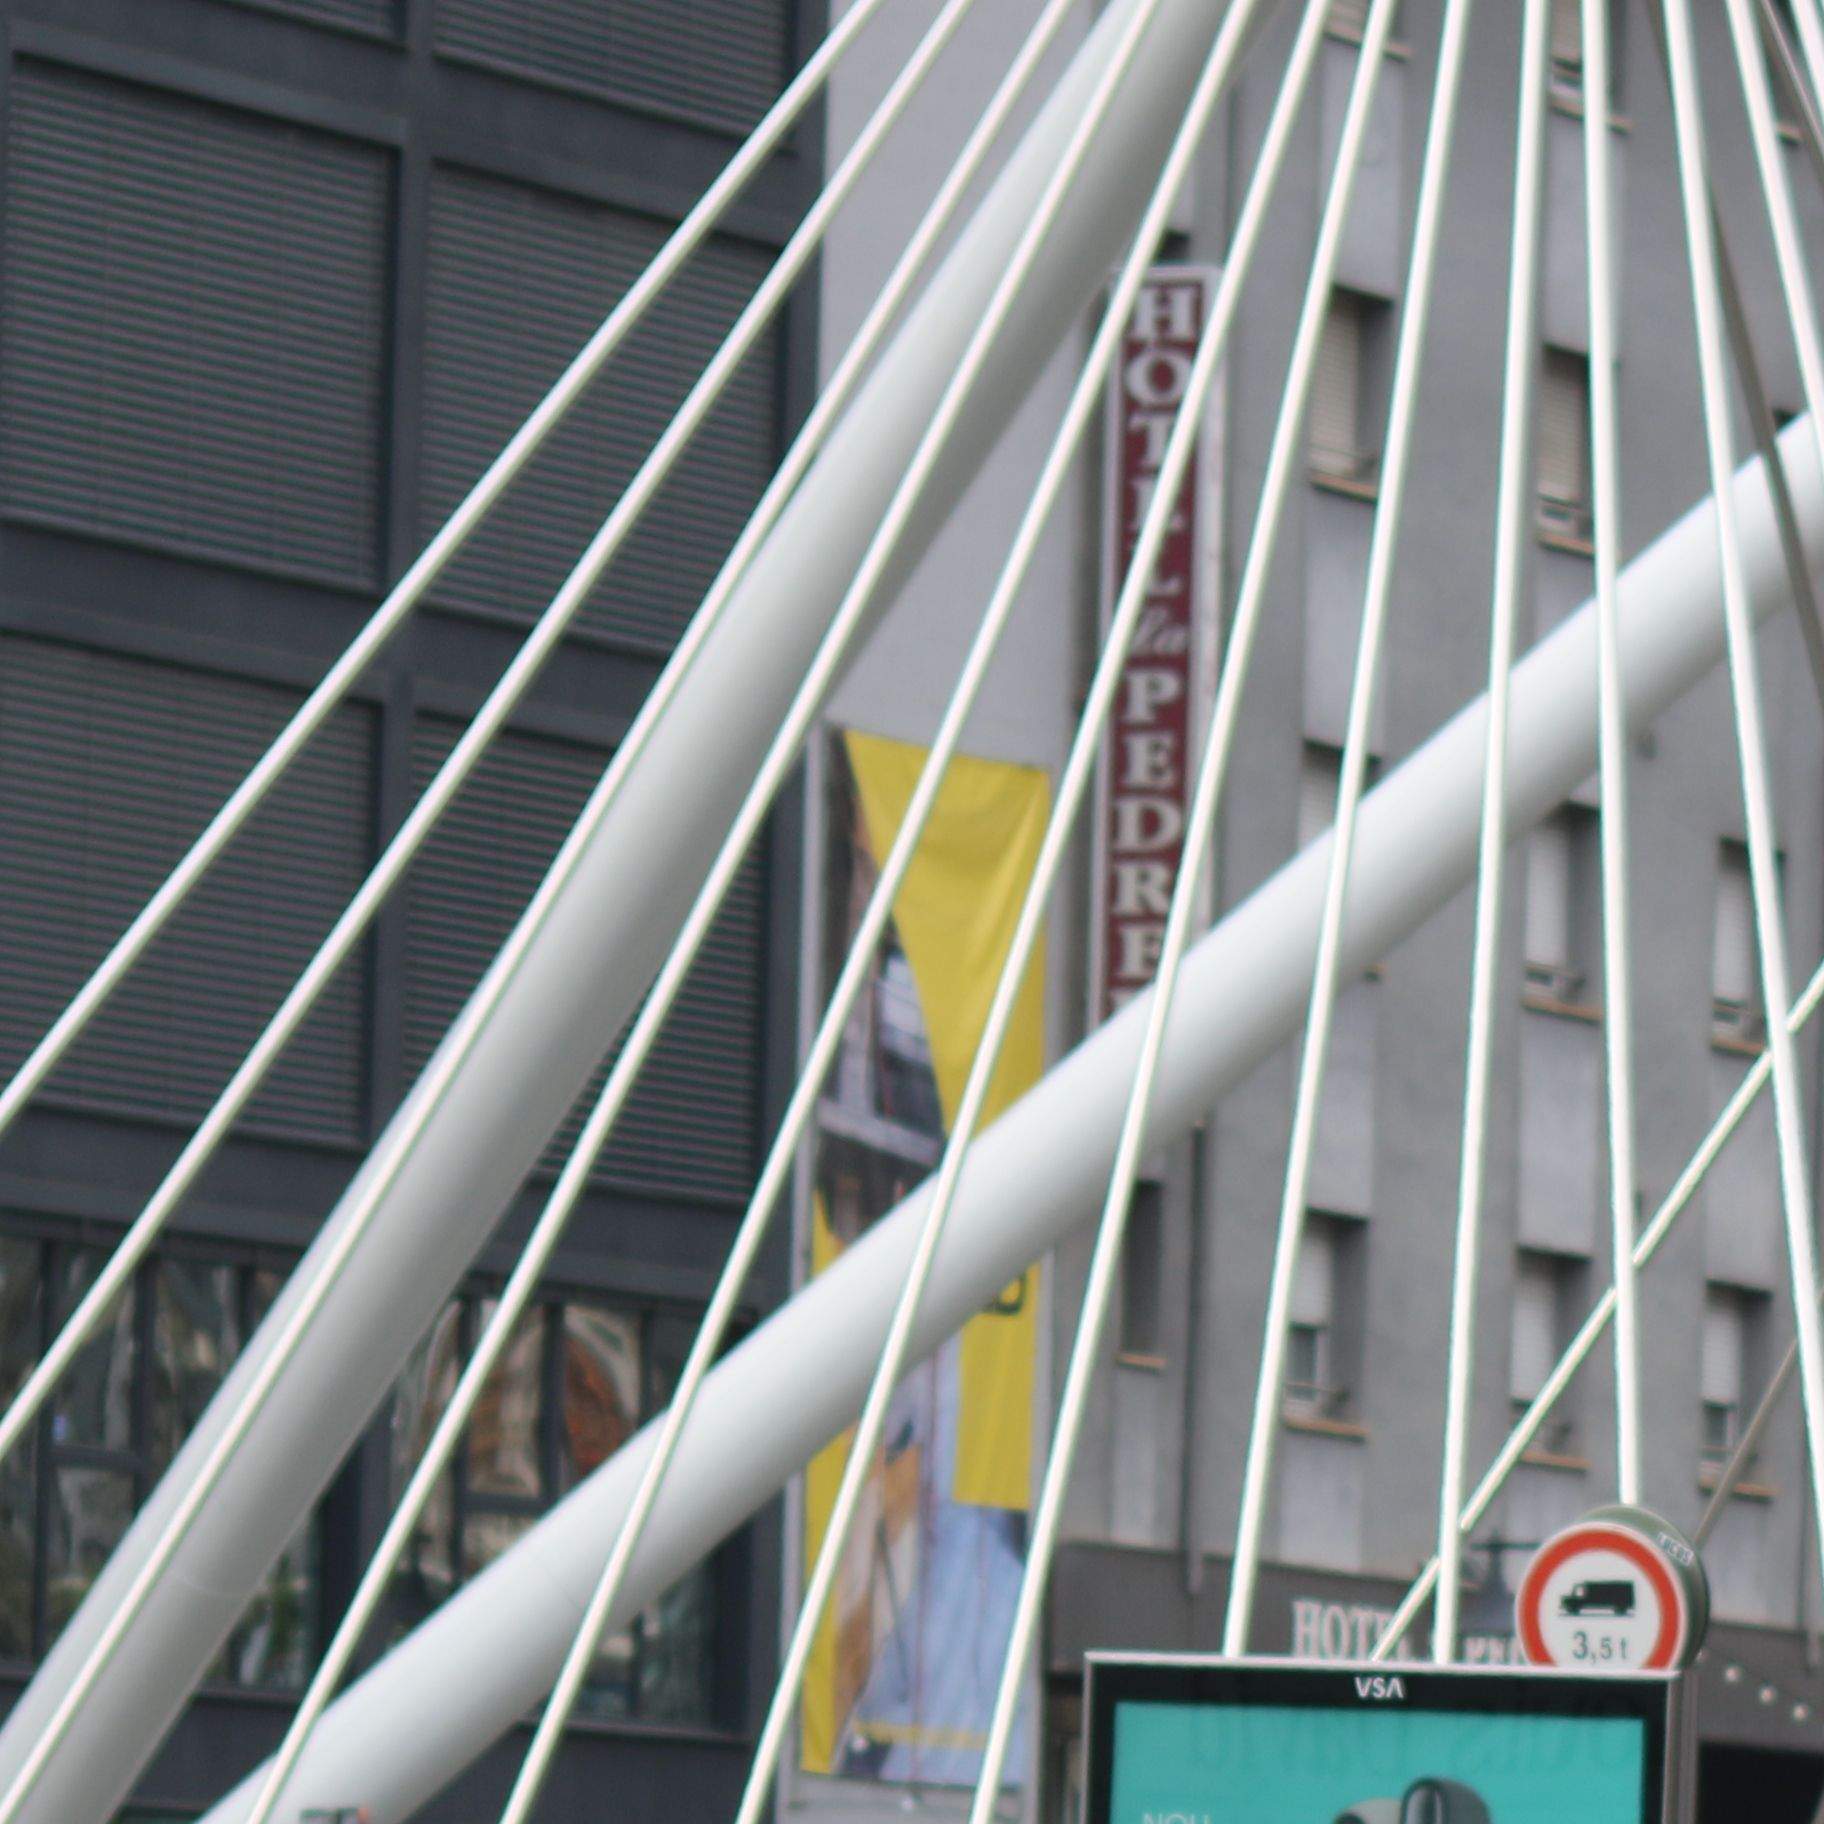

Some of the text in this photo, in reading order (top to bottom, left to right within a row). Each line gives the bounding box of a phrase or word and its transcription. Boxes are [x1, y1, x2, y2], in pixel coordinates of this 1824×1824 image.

[1108, 667, 1183, 1010] PEDRE
[1293, 1599, 1413, 1661] HOT
[1354, 1677, 1406, 1699] VSA
